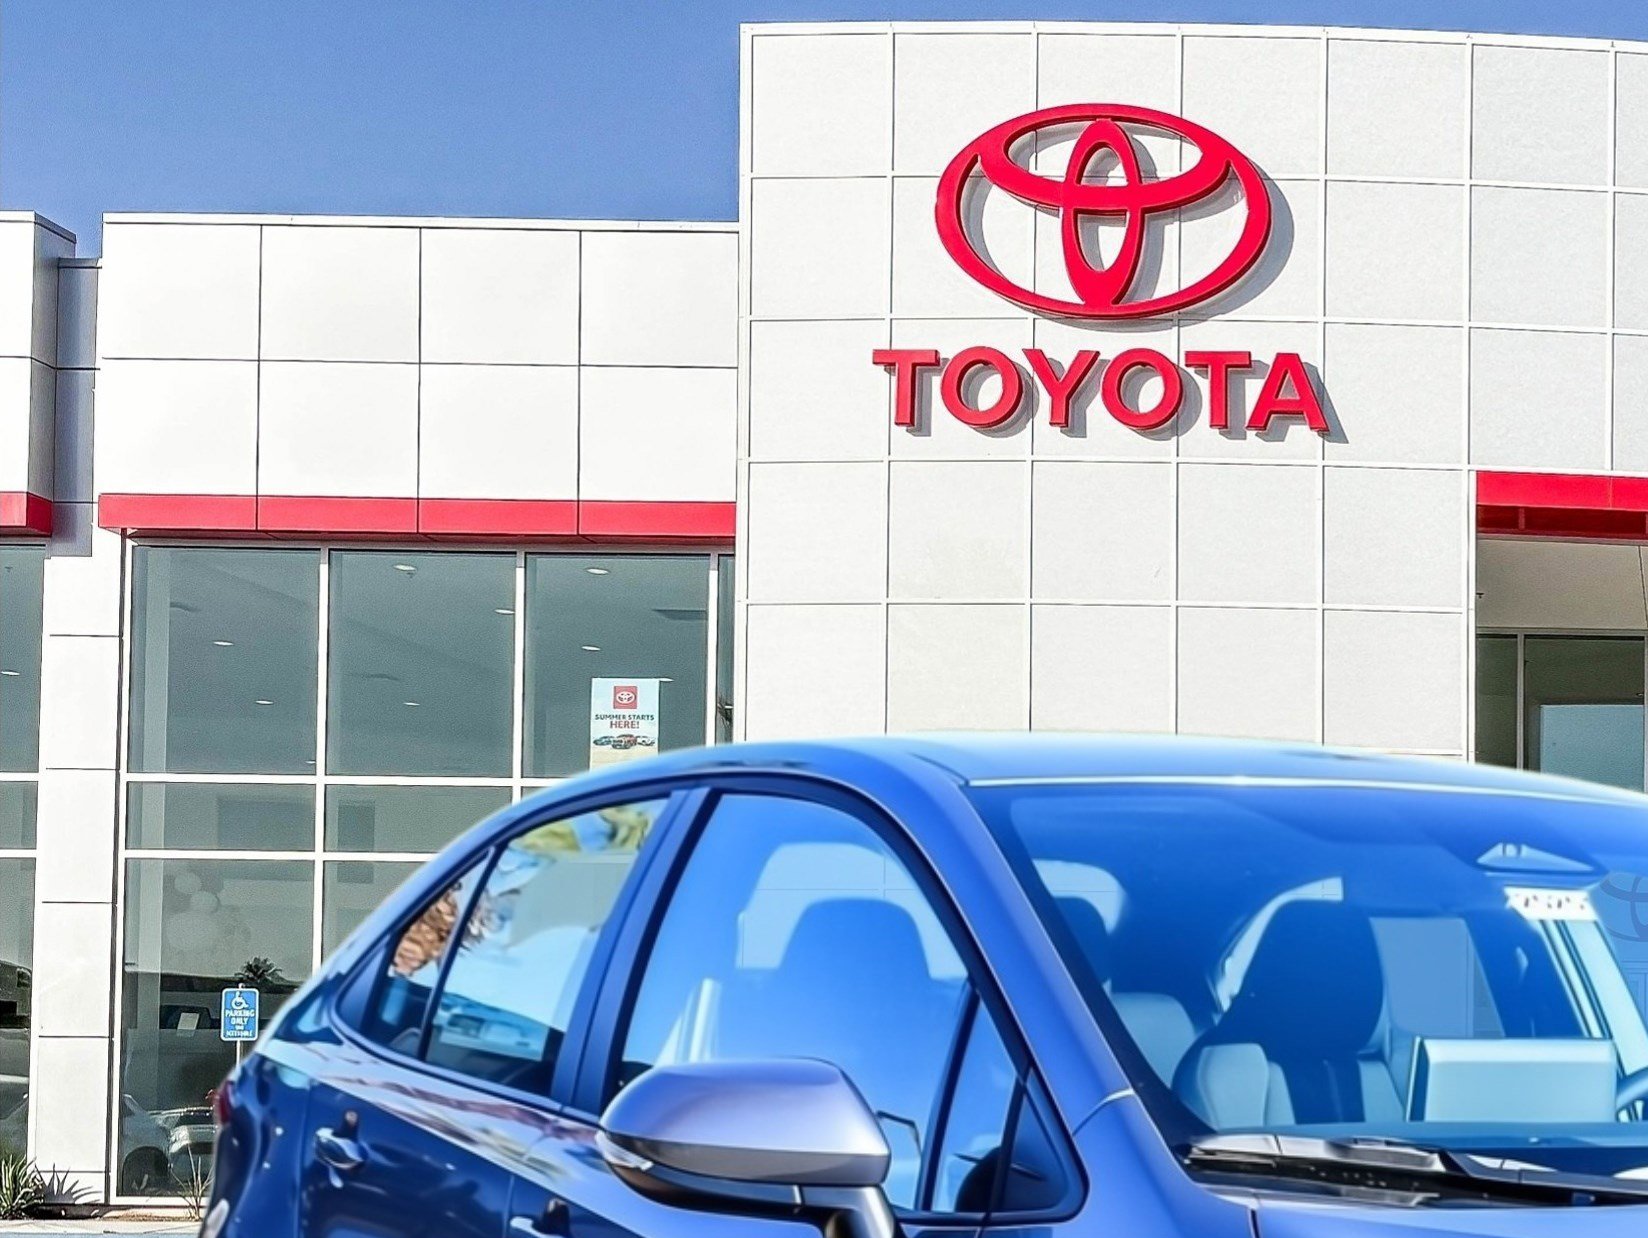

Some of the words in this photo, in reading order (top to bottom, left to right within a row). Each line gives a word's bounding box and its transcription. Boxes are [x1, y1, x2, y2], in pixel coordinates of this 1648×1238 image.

[872, 345, 1329, 432] TOYOTA
[609, 720, 640, 729] HERE!
[225, 1009, 255, 1017] PARKING
[230, 1017, 249, 1025] ONLY
